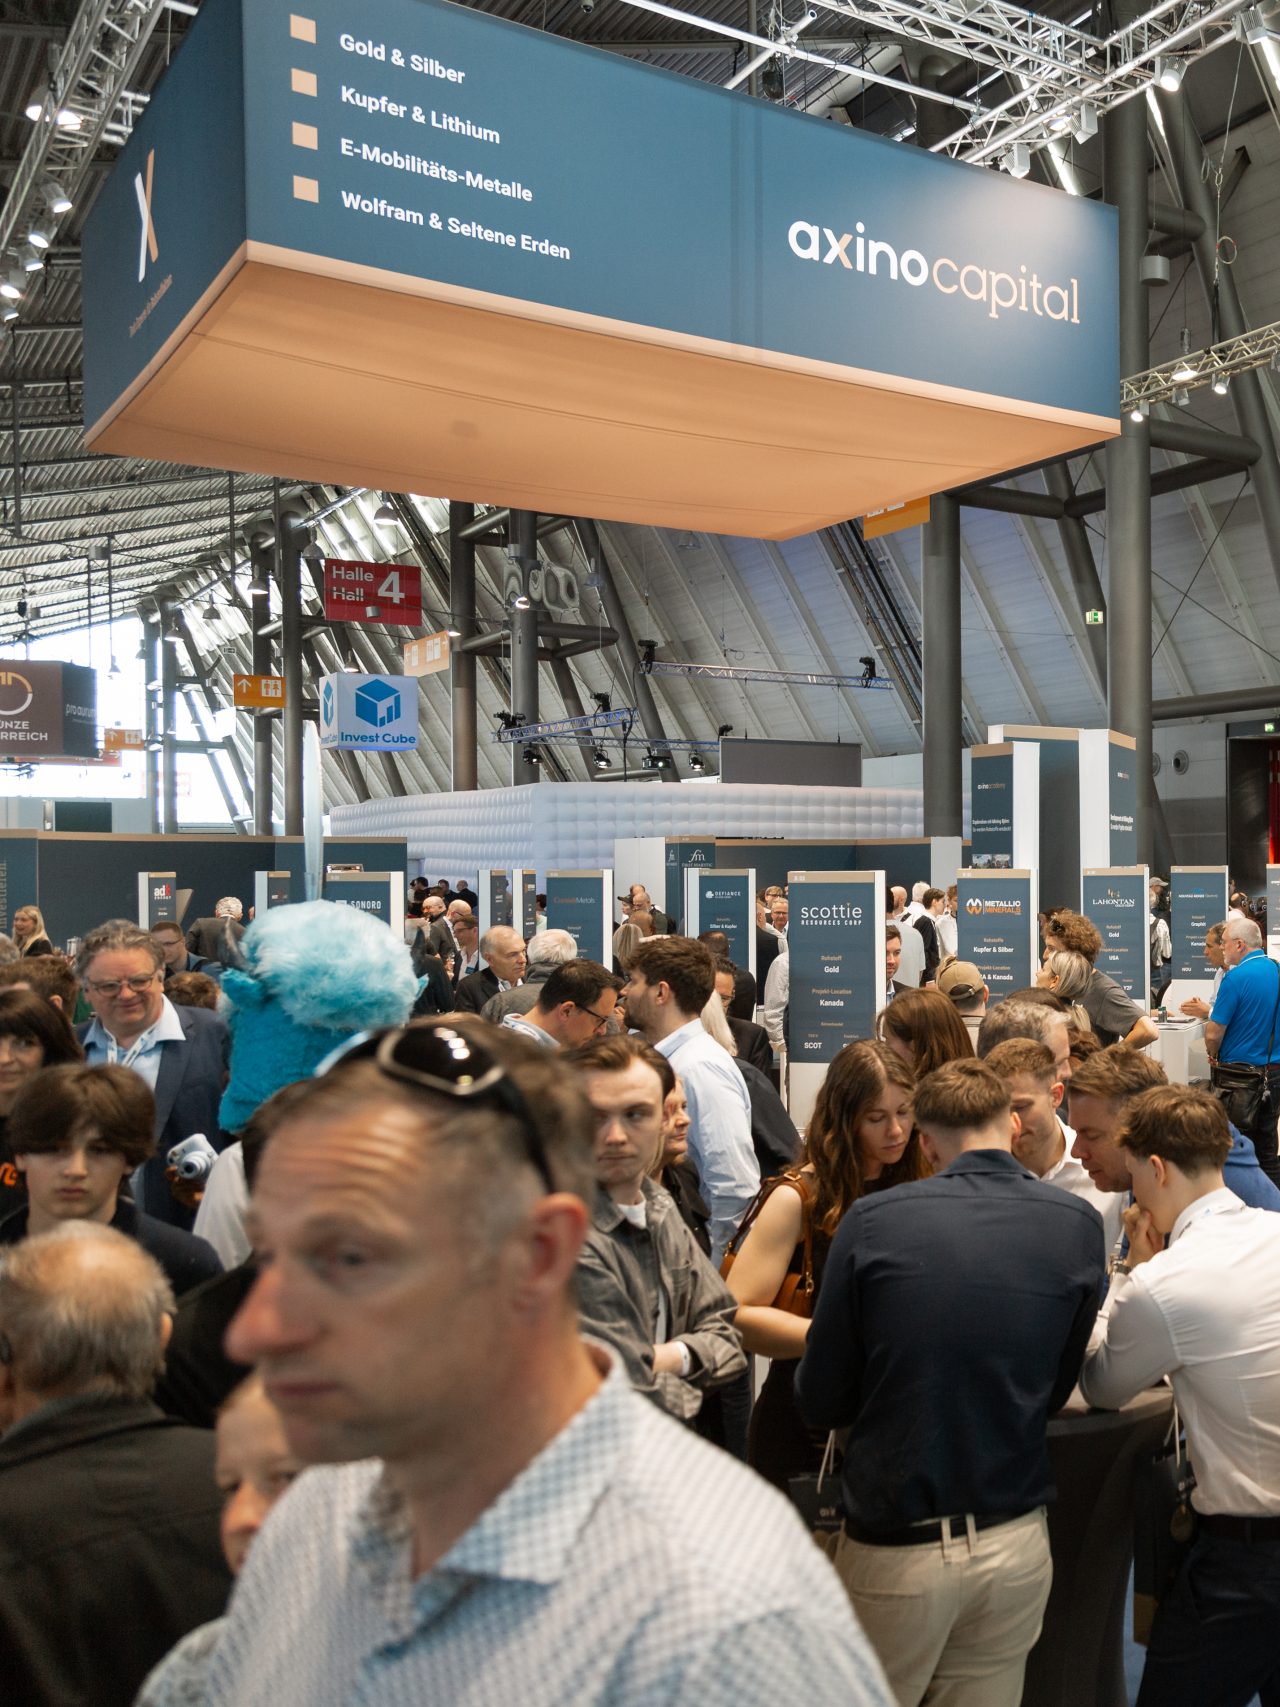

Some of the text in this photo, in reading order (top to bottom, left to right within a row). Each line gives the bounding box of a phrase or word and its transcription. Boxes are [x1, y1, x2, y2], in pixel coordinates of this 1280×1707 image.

[340, 33, 465, 83] Gold & Silber
[341, 85, 500, 144] Kupfer & Lithium
[340, 138, 533, 202] E-Mobilitäts-Metalle
[341, 190, 570, 260] Wolfram & Seltene Erden
[332, 565, 374, 582] Halle
[332, 586, 364, 602] Hall
[377, 571, 406, 604] 4
[340, 731, 380, 743] Invest
[382, 733, 416, 744] Cube
[801, 903, 862, 918] scottie
[973, 946, 992, 954] Kupfer
